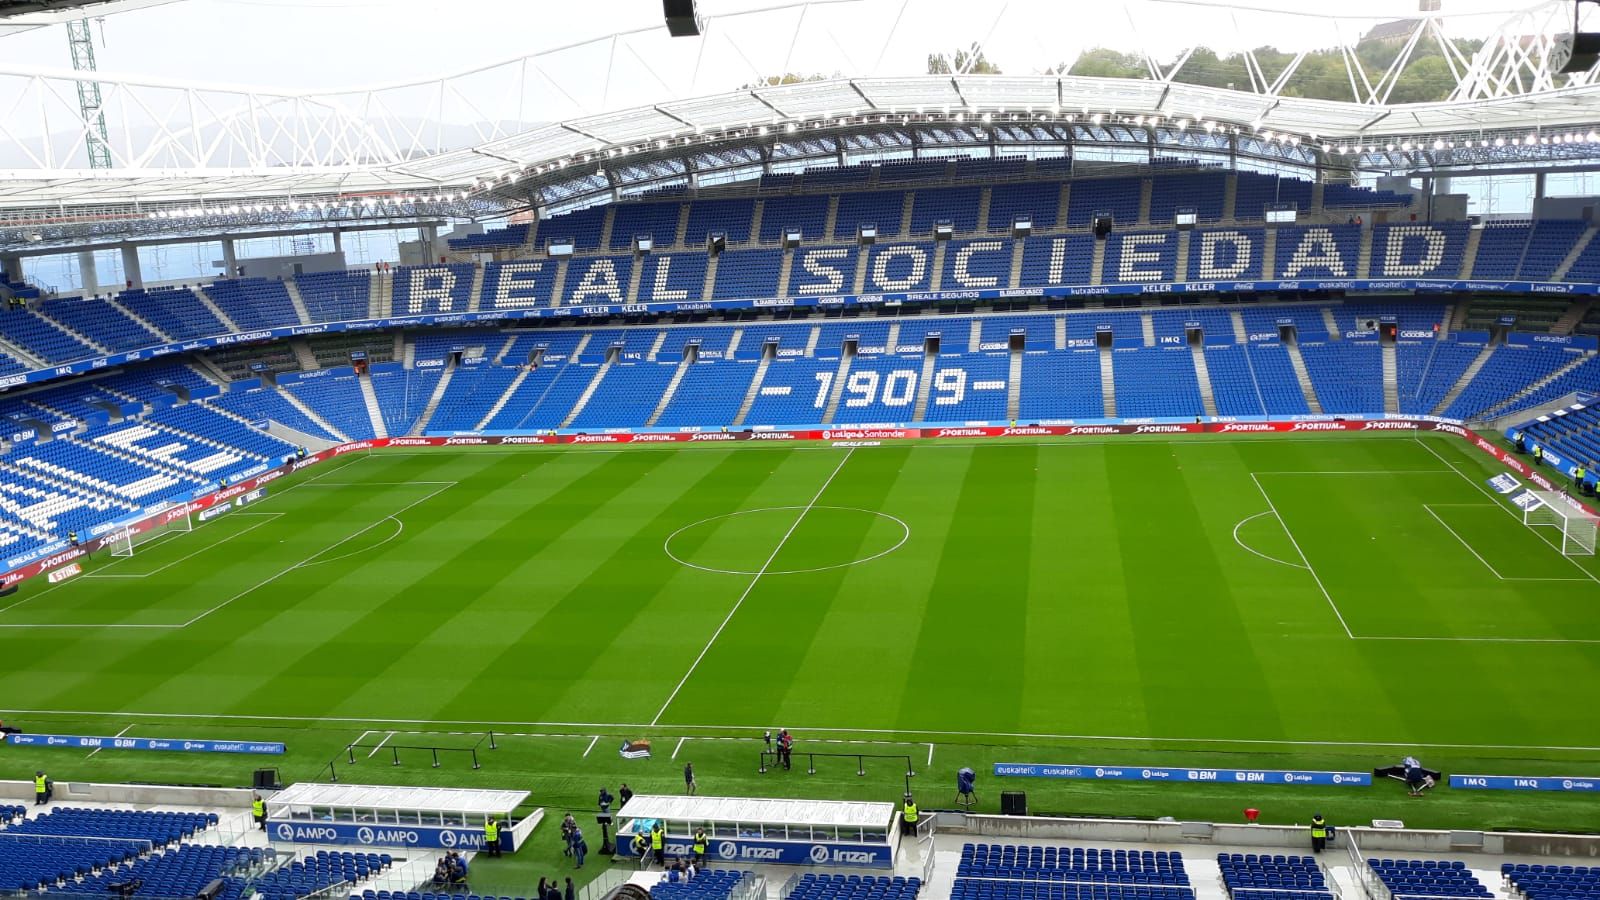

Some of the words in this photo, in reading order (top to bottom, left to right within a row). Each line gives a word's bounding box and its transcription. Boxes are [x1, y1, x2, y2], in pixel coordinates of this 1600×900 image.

[408, 256, 702, 313] REAL
[796, 226, 1447, 297] SOCIEDAD
[1071, 287, 1110, 295] kutxabank
[1143, 284, 1172, 292] KELER
[1186, 283, 1215, 291] KELER
[941, 291, 980, 299] SEGUROS
[583, 306, 609, 314] KELER
[621, 305, 648, 313] KELER
[216, 336, 234, 345] REAL
[237, 331, 272, 343] SOCIEDAD
[56, 366, 73, 376] IMQ
[22, 429, 35, 441] BM
[832, 430, 857, 439] LaLiga
[864, 429, 906, 438] Santander
[15, 552, 38, 568] REALE
[54, 564, 81, 582] STIHL
[88, 738, 102, 747] BM
[122, 739, 136, 748] BM
[997, 766, 1031, 775] euskaltel
[1043, 767, 1076, 776] euskaltel
[1199, 771, 1217, 780] BM
[1246, 773, 1265, 781] BM
[1463, 778, 1489, 787] IMQ
[1514, 779, 1540, 788] IMQ
[296, 828, 337, 840] AMPO
[377, 831, 419, 843] AMPO
[741, 845, 784, 860] Irizar
[833, 849, 878, 864] Irizar
